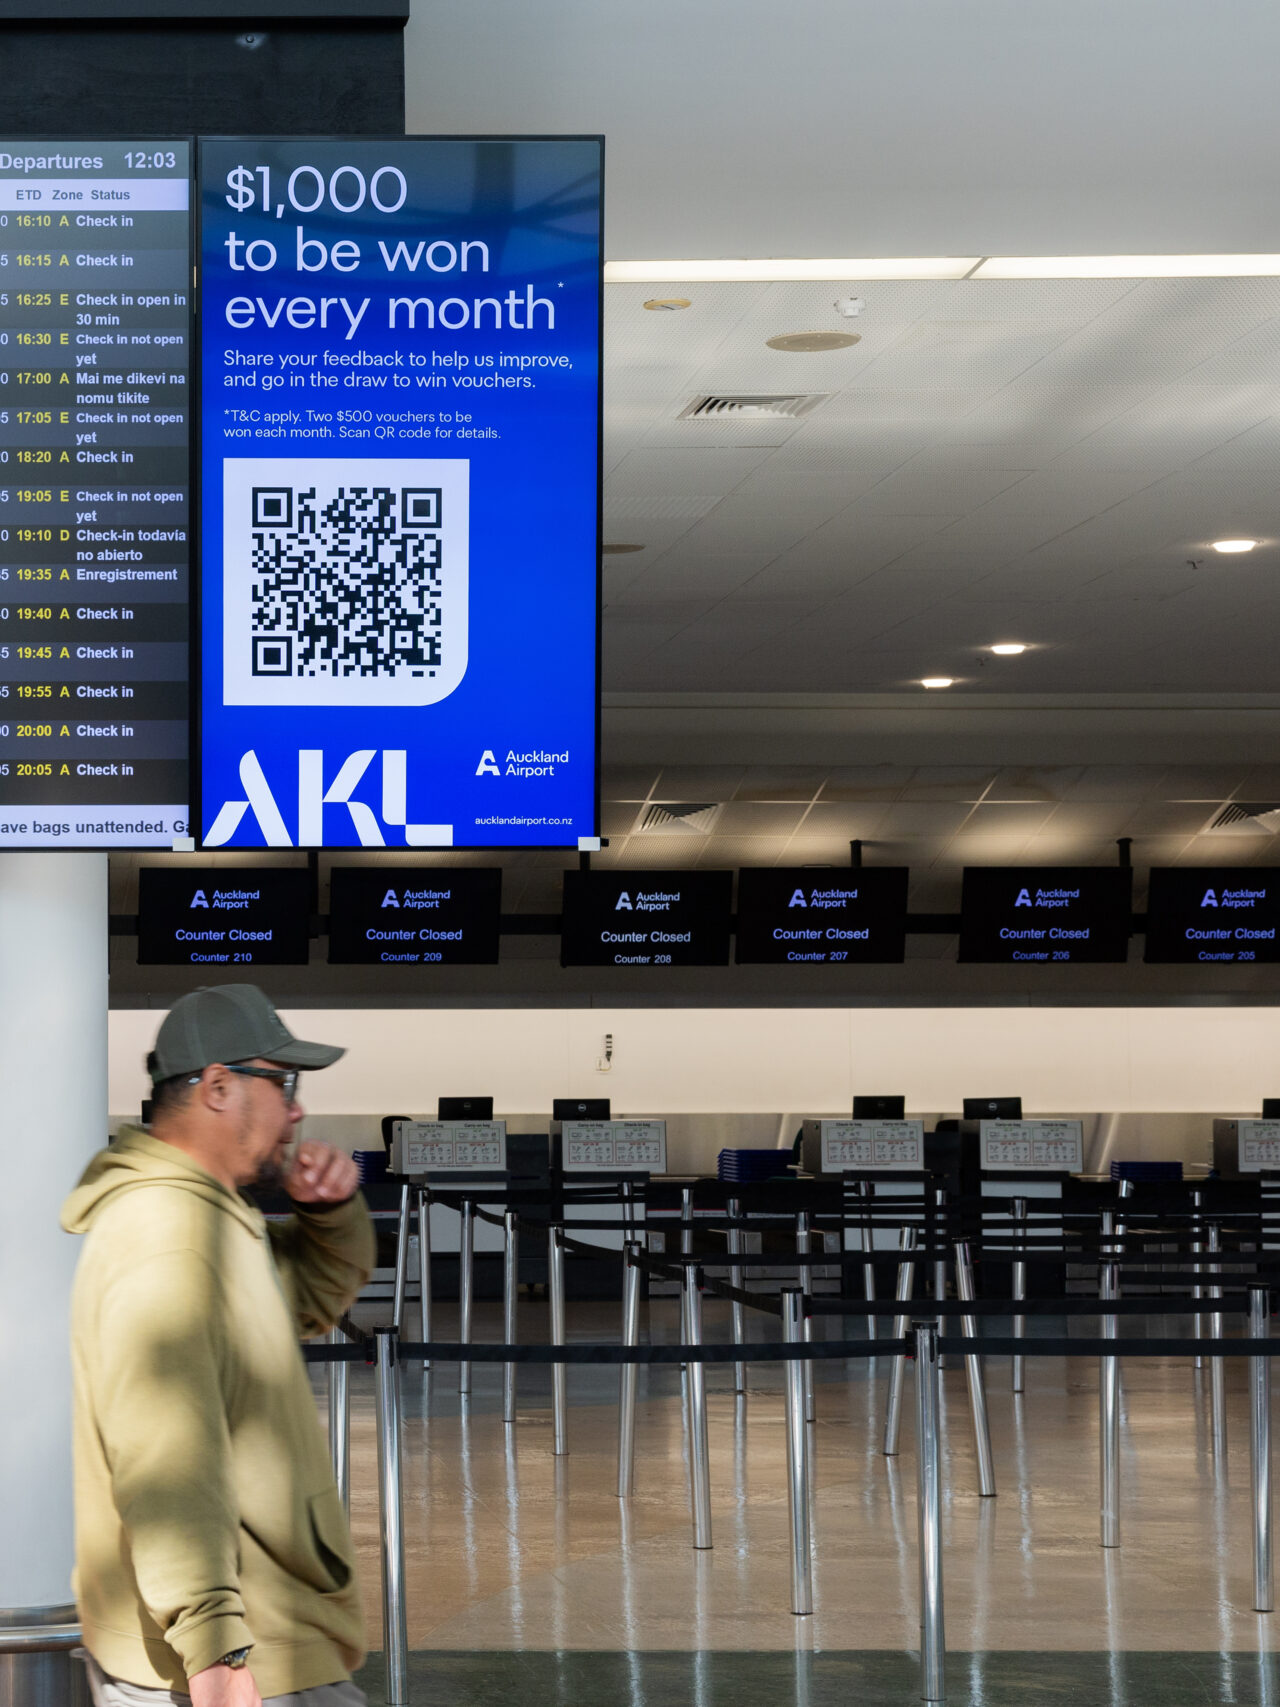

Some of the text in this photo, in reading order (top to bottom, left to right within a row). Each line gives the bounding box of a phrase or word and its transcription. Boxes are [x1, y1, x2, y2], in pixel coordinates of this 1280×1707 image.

[0, 154, 103, 173] Departures
[125, 152, 175, 168] 12:03
[226, 165, 407, 218] $1,000
[224, 226, 488, 272] to be won
[226, 297, 370, 340] every
[224, 350, 572, 370] Share your feedback to help us improve,
[224, 371, 535, 390] and go in the draw to win vouchers.
[264, 410, 301, 426] apply.
[306, 410, 332, 421] Two
[337, 410, 372, 422] $500
[376, 411, 435, 422] vouchers
[439, 412, 452, 422] to
[456, 411, 472, 422] be
[224, 426, 500, 439] won each month. Scan QR code for details.
[17, 530, 51, 541] 19:10
[60, 530, 69, 541] D
[77, 530, 134, 541] Check-in
[138, 530, 186, 541] todavía
[77, 549, 143, 560] no abierto
[17, 569, 51, 580] 19:35
[60, 569, 69, 580] A
[77, 569, 177, 582] Enregistrement
[506, 750, 568, 763] Auckland
[506, 764, 554, 777] Airport
[202, 749, 453, 846] AKL
[475, 816, 572, 826] aucklandairport.co.nz
[213, 890, 259, 900] Auckland
[636, 892, 680, 901] Auckland
[811, 889, 857, 898] Auckland
[1222, 889, 1265, 898] Auckland
[213, 900, 248, 910] Airport
[636, 902, 669, 912] Airport
[811, 898, 846, 909] Airport
[1221, 898, 1254, 909] Airport
[176, 929, 272, 940] Counter Closed
[601, 931, 690, 942] Counter Closed
[773, 928, 869, 939] Counter Closed
[1186, 928, 1275, 939] Counter Closed
[191, 953, 252, 961] Counter 210
[615, 955, 671, 963] Counter 208
[787, 952, 848, 960] Counter 207
[1198, 951, 1255, 960] Counter 205
